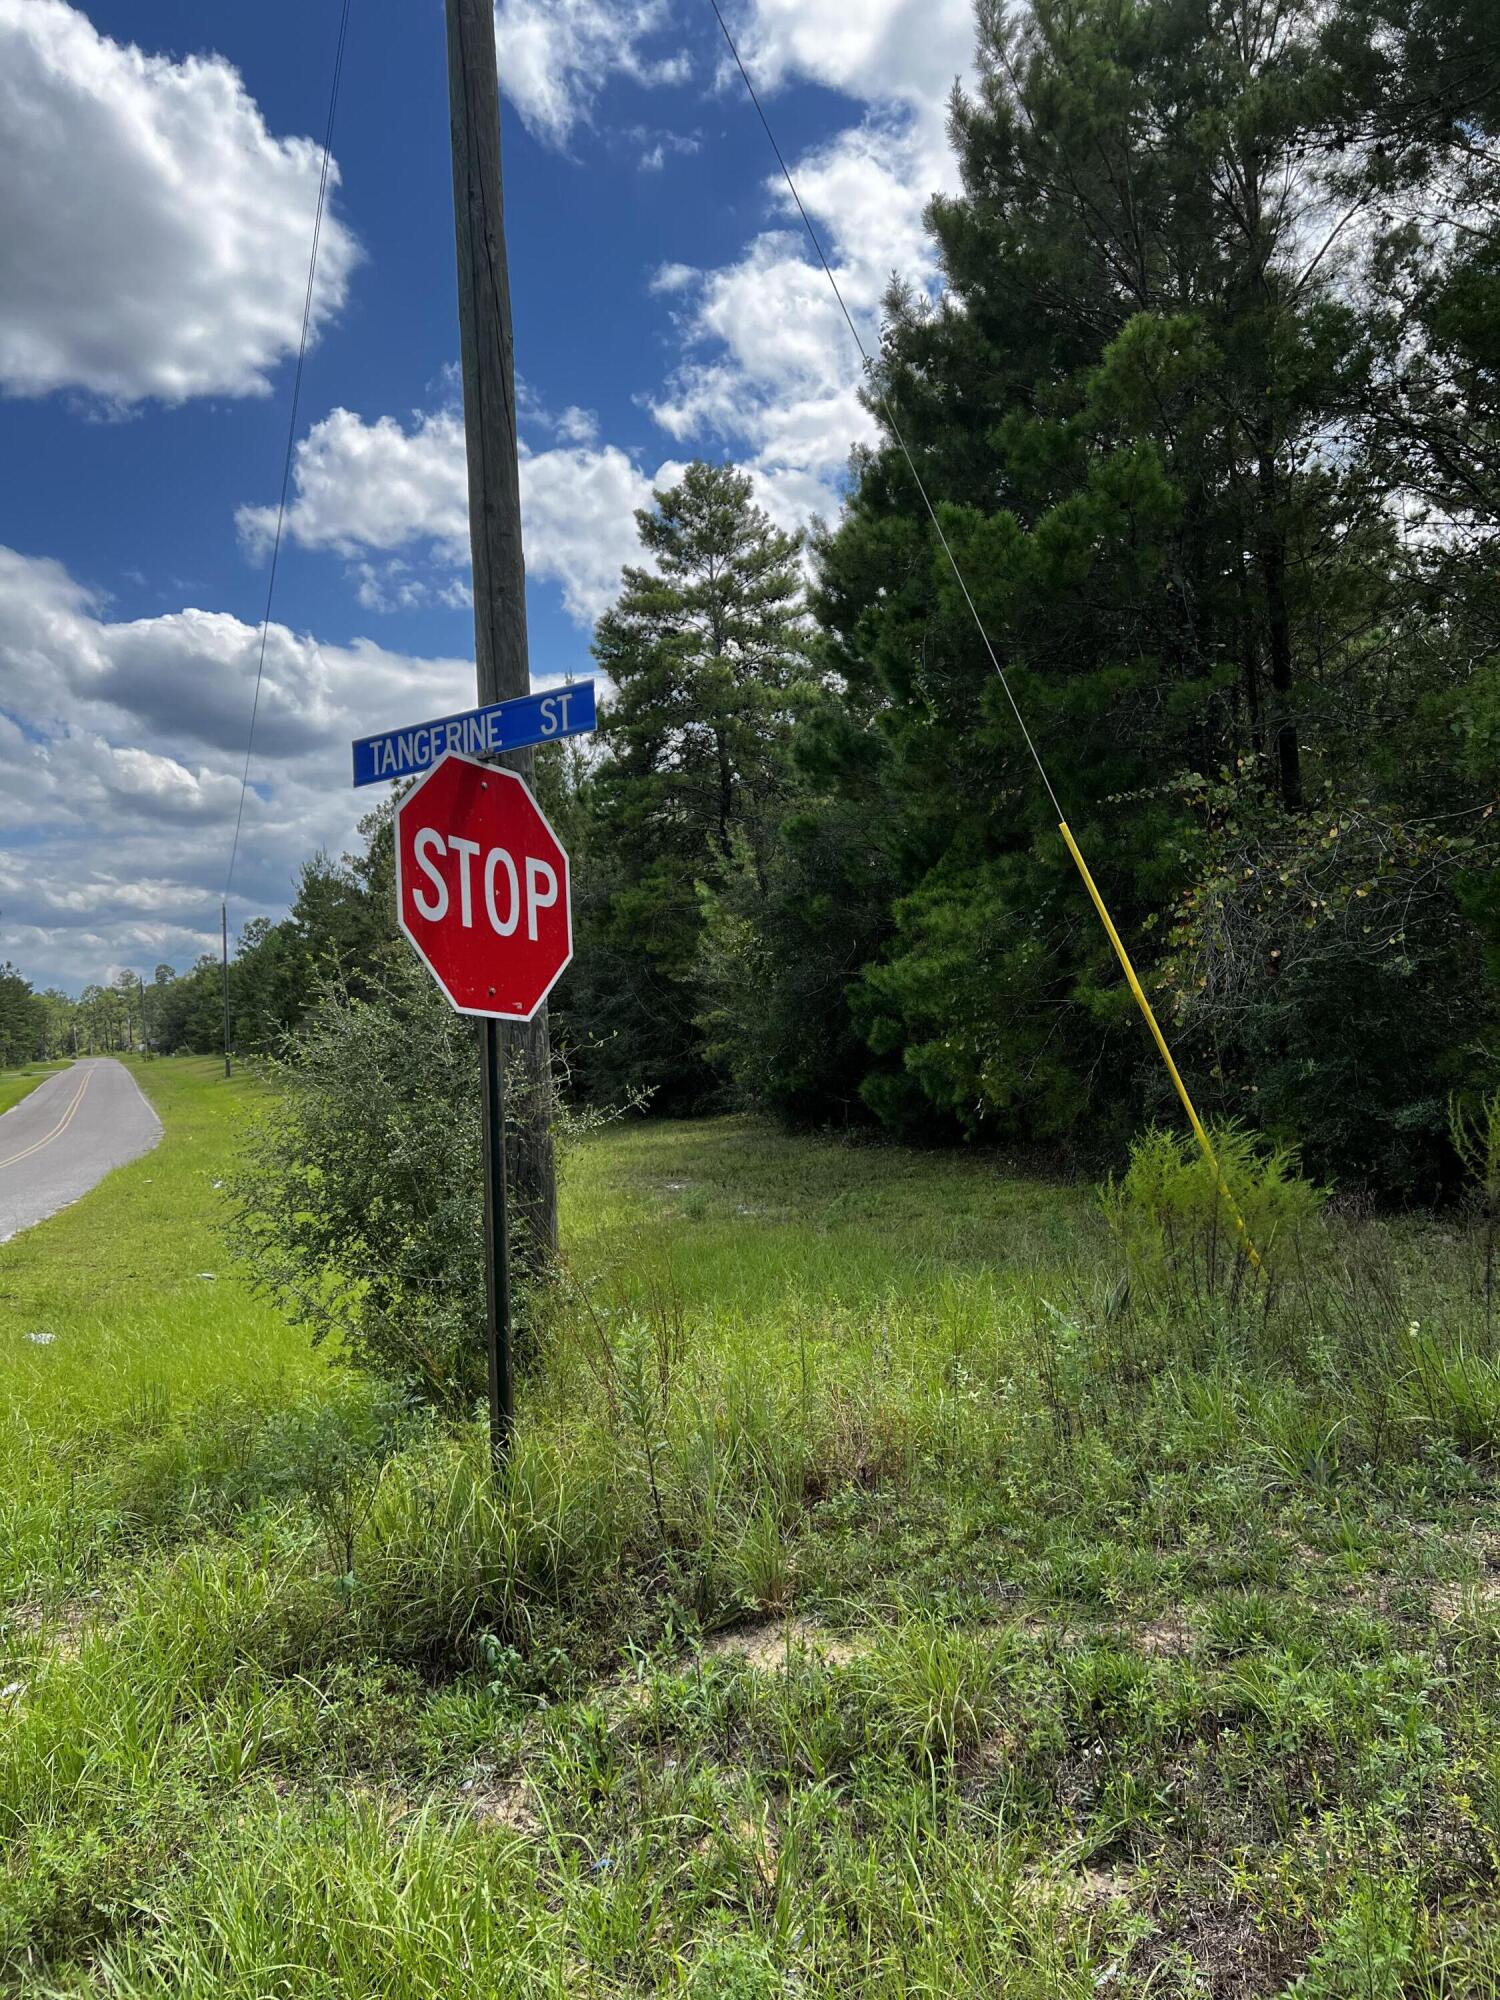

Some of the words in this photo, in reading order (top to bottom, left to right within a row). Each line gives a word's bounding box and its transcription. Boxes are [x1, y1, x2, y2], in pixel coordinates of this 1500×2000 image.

[369, 711, 503, 776] TANGERINE
[540, 693, 573, 736] ST
[412, 827, 558, 942] STOP
